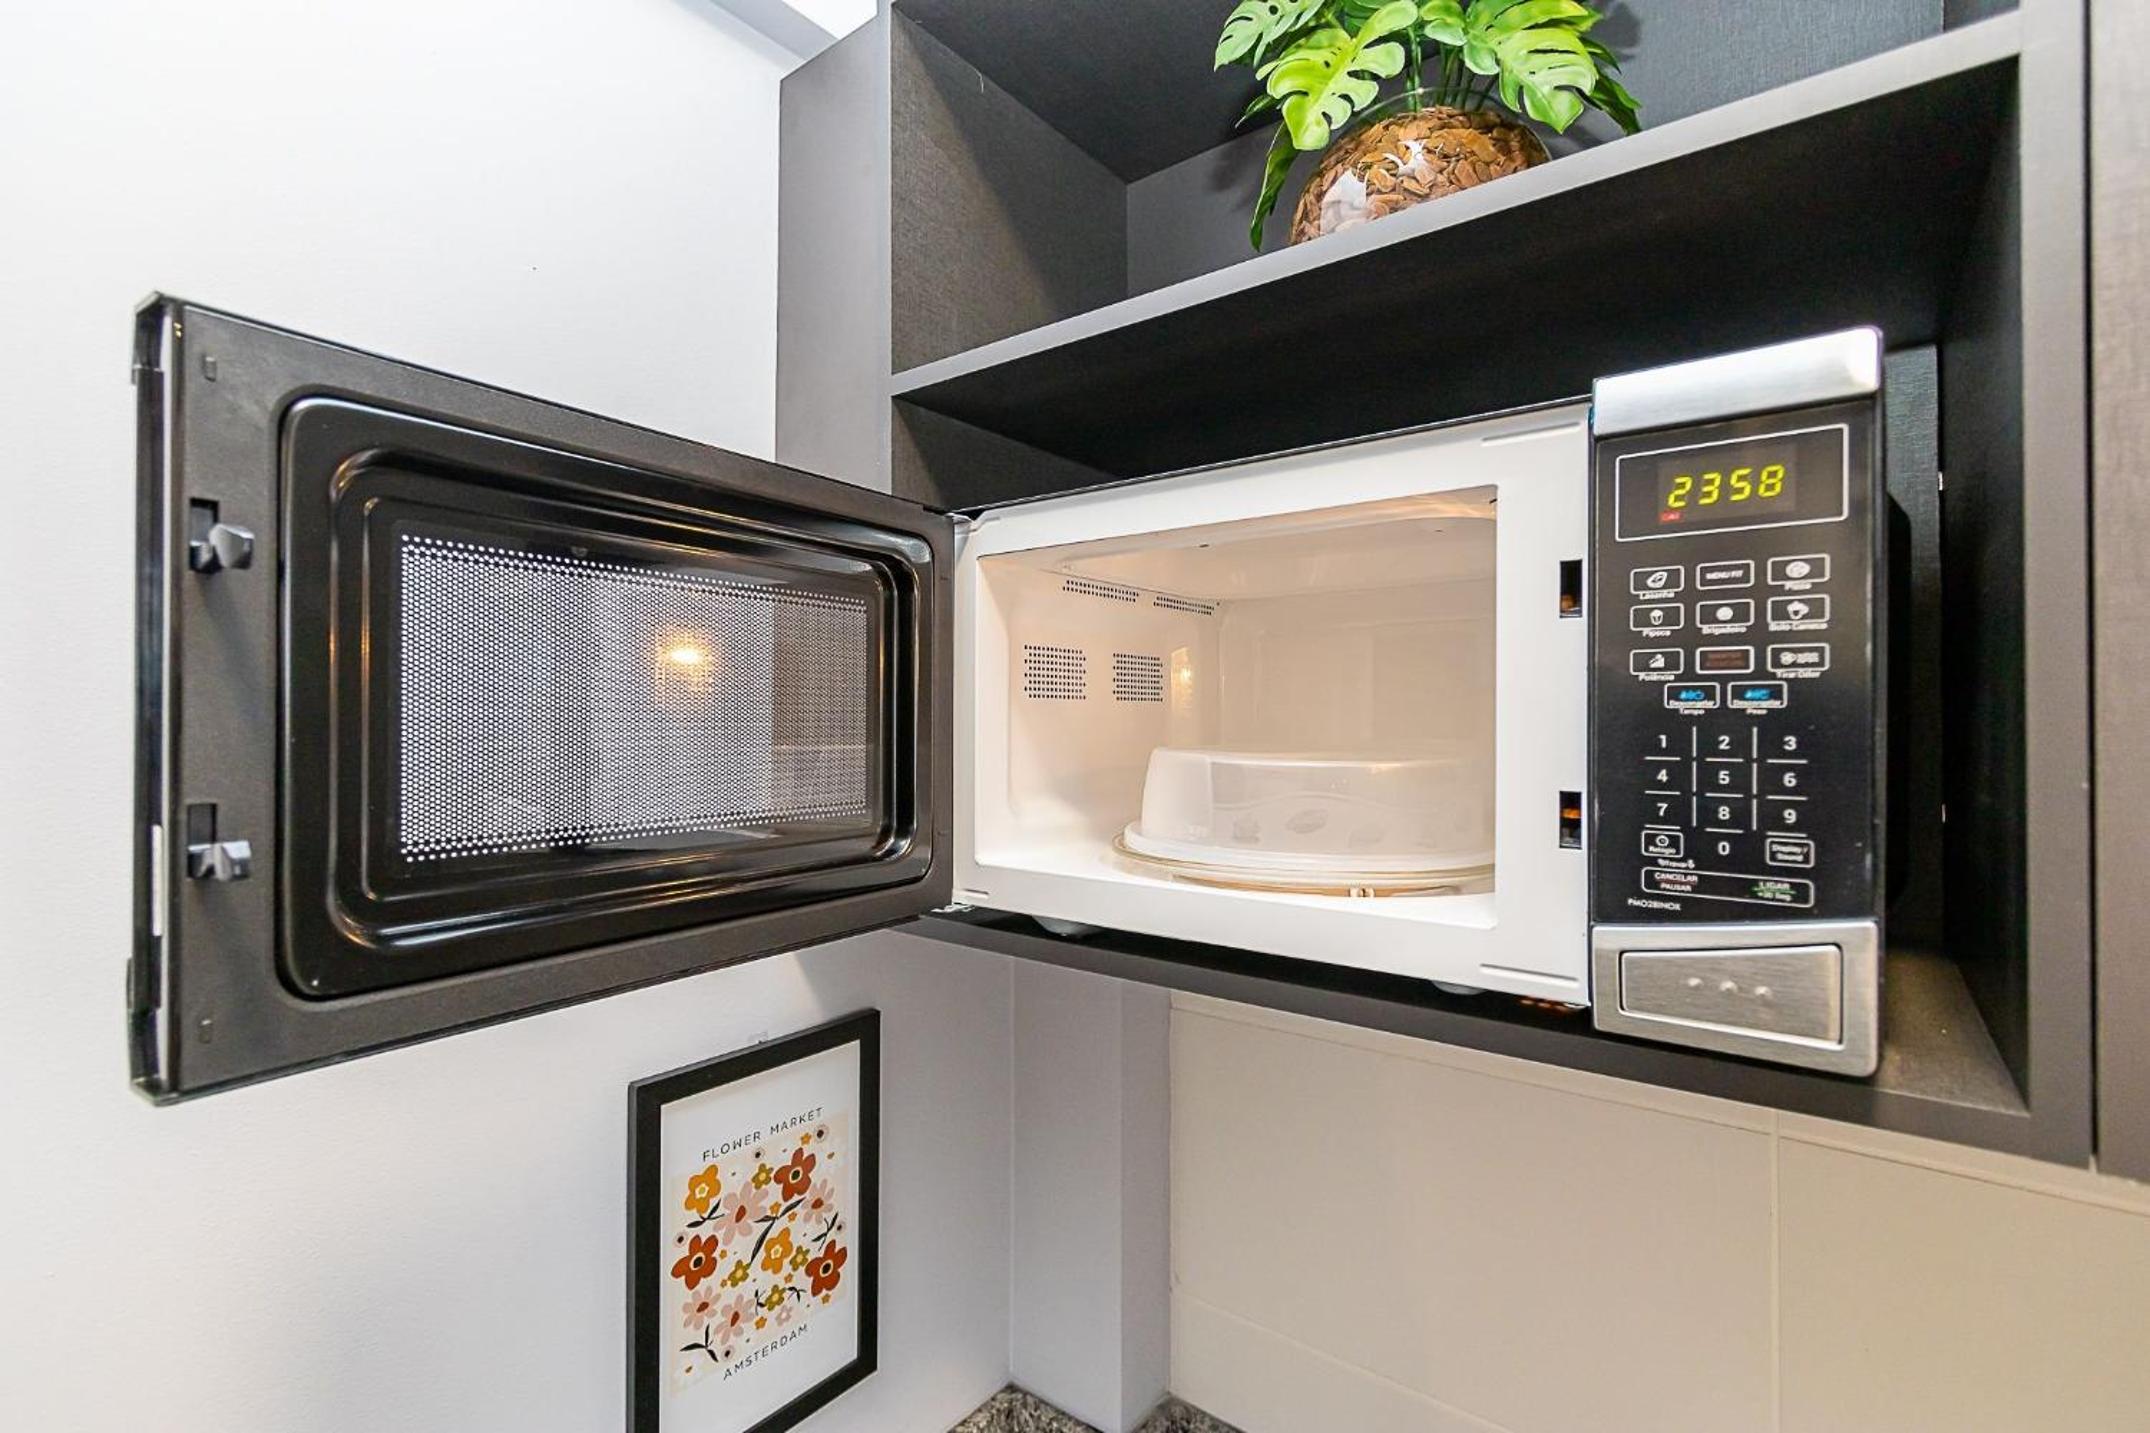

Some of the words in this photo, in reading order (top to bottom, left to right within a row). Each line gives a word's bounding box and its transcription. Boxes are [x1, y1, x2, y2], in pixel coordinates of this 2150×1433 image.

[1667, 464, 1786, 508] 2358
[1657, 734, 1668, 749] 1
[1718, 735, 1730, 750] 2
[1782, 735, 1797, 751] 3
[1656, 768, 1669, 783] 4
[1718, 770, 1731, 785] 5
[1782, 772, 1797, 788] 6
[1656, 803, 1669, 817] 7
[1717, 805, 1730, 820] 8
[1782, 808, 1797, 824] 9
[1717, 841, 1730, 856] 0
[1654, 872, 1698, 883] CANCELAR
[702, 1130, 761, 1162] FLOWER
[769, 1107, 824, 1136] MARKET
[723, 1323, 808, 1381] AMSTERDAM
